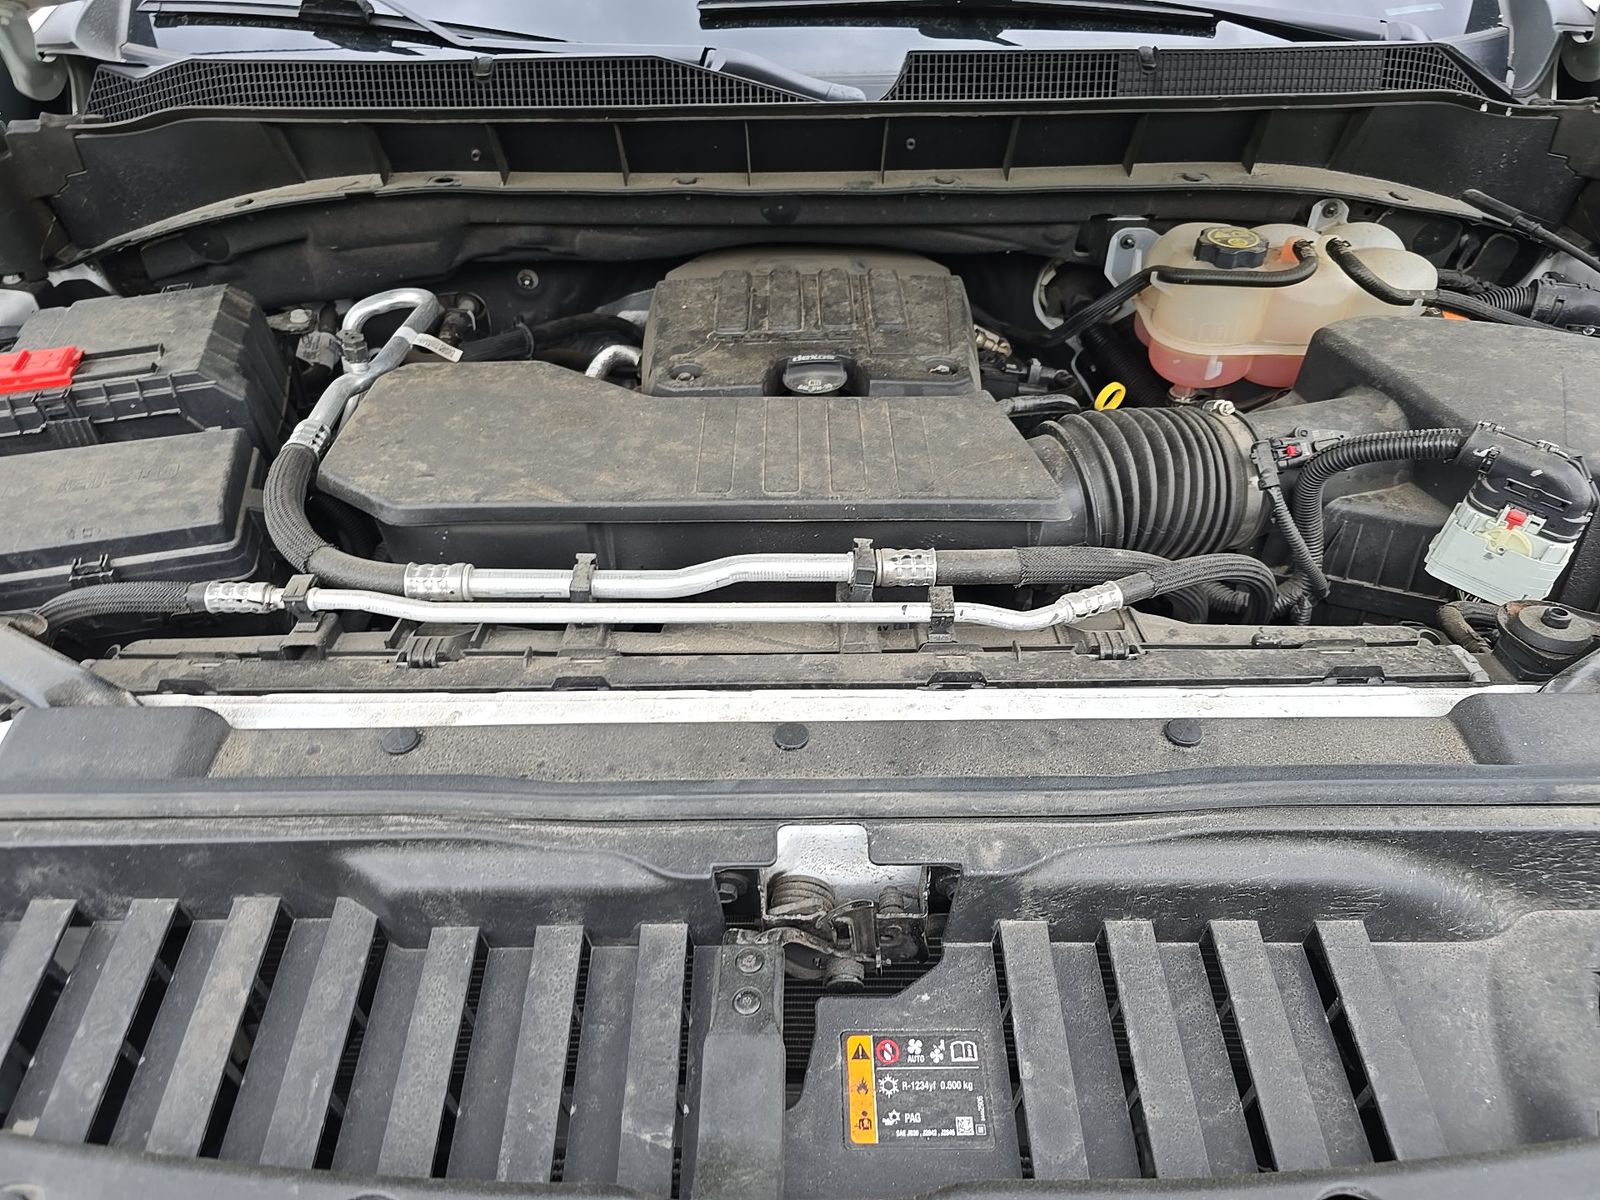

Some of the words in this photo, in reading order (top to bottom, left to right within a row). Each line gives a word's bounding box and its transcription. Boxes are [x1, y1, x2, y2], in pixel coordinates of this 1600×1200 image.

[907, 1055, 925, 1063] AUTO
[902, 1080, 936, 1092] R-1234yf
[963, 1080, 974, 1091] kg
[904, 1112, 921, 1123] PAG
